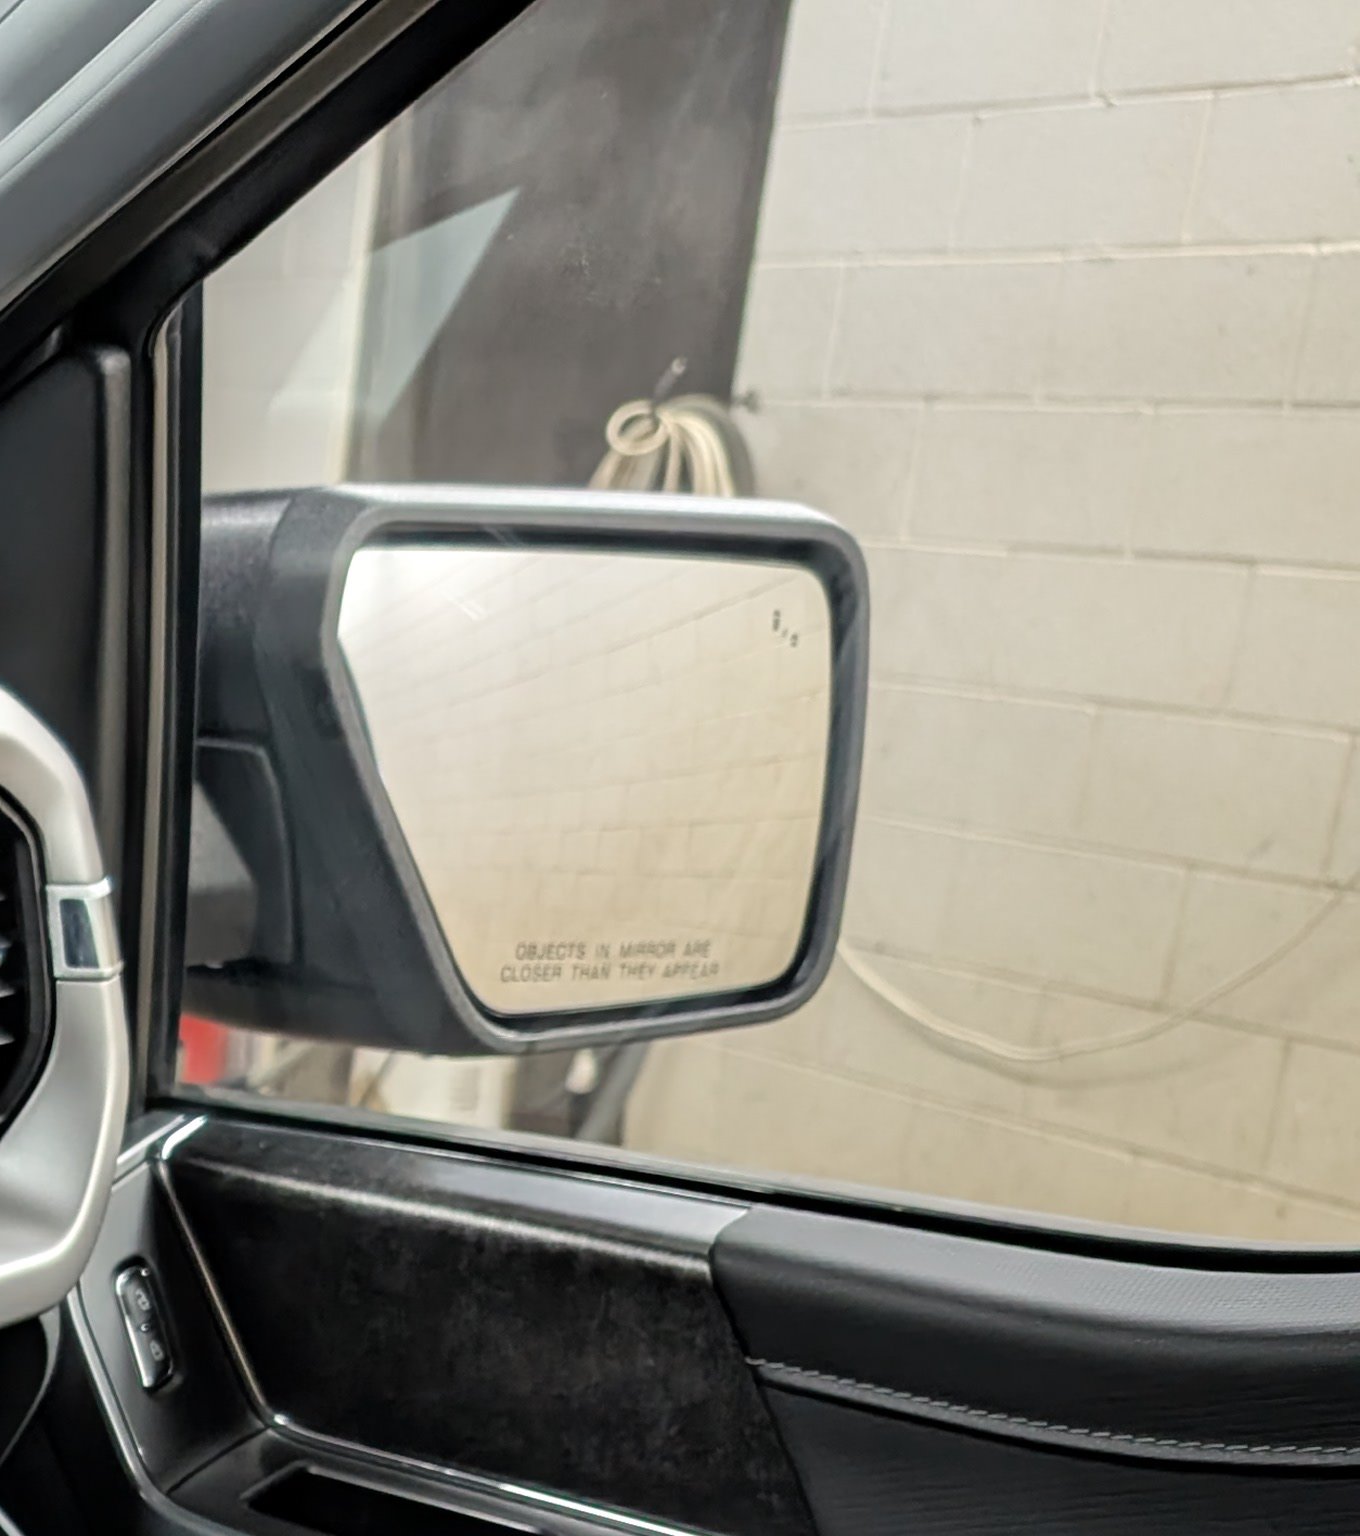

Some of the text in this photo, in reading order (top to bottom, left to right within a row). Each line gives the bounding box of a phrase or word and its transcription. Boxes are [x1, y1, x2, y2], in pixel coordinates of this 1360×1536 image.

[514, 938, 711, 961] OBJECTS IN MIRROR ARE
[499, 960, 720, 983] CLOSER THAN THEY APPEAR
